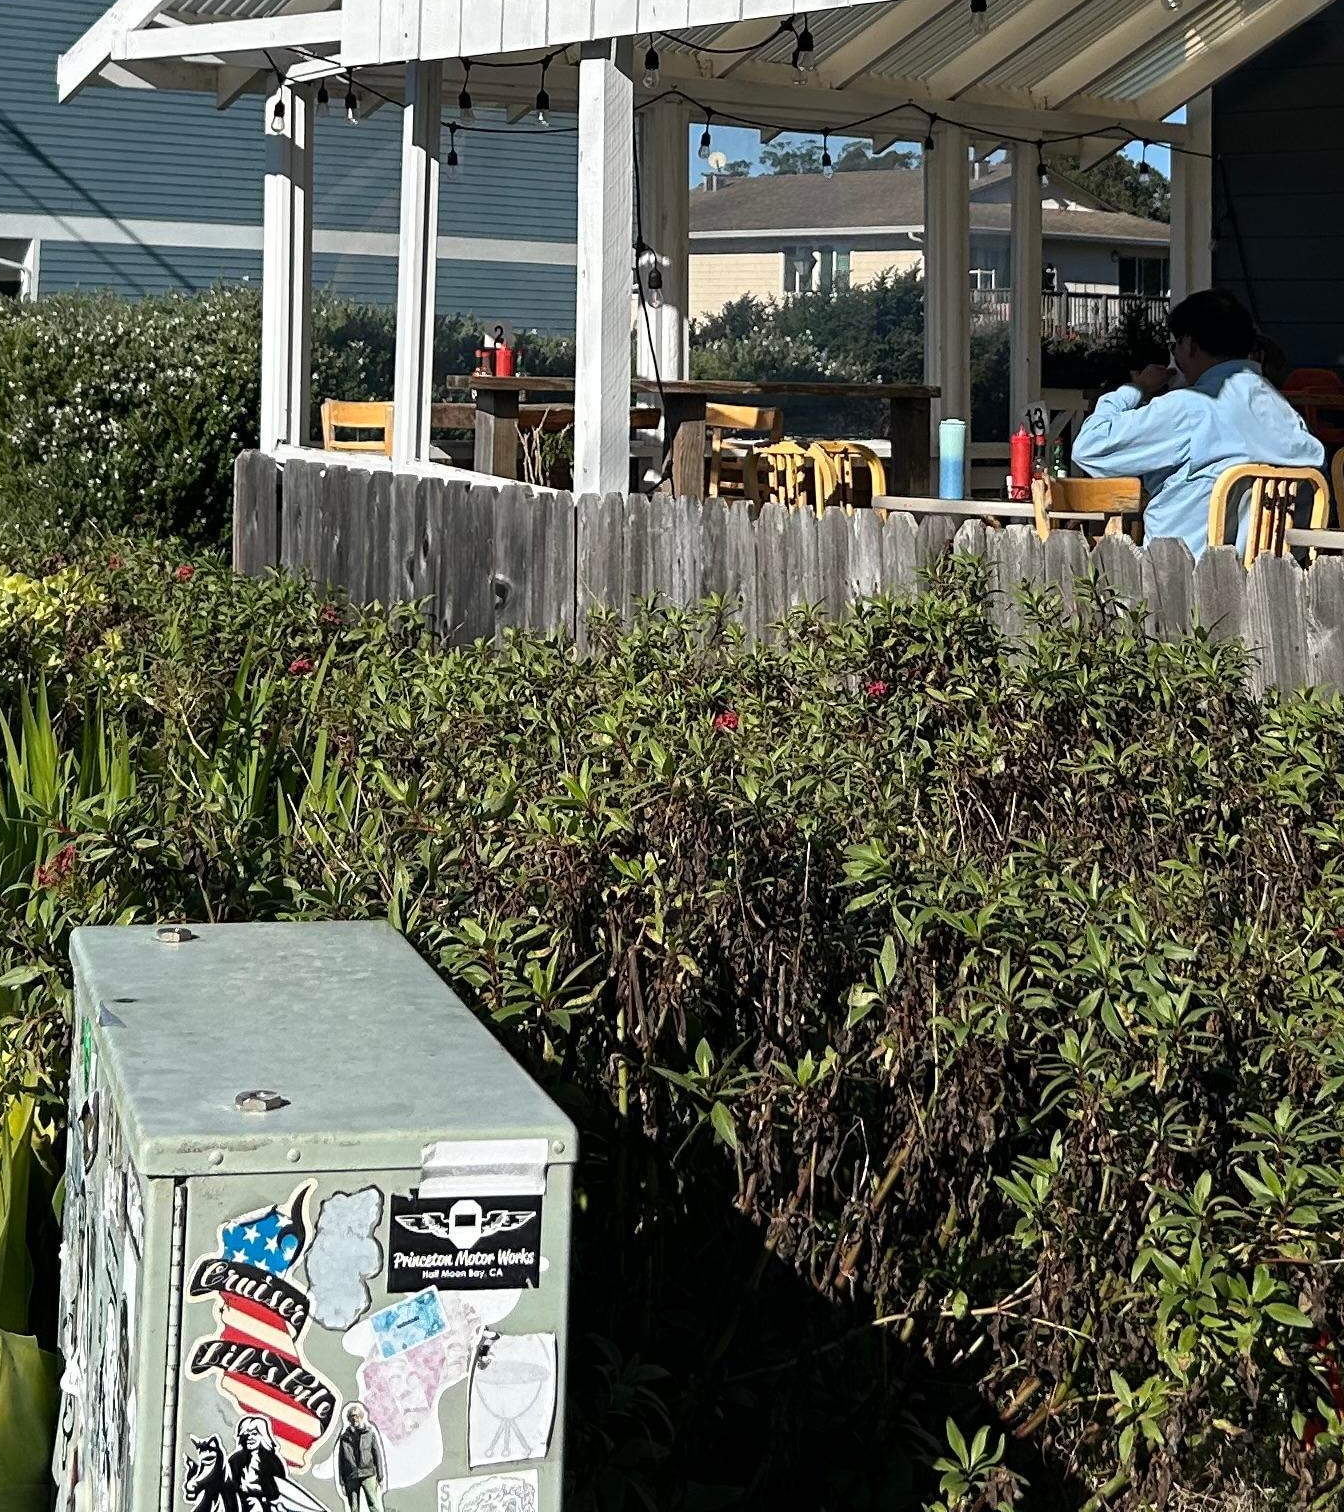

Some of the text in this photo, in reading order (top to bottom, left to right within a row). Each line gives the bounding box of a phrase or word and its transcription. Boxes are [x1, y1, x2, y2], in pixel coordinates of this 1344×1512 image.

[494, 325, 504, 348] 2
[393, 1248, 534, 1269] Princeton Motor Works
[441, 1269, 466, 1278] Moon
[489, 1268, 503, 1277] CA
[201, 1262, 304, 1326] Cruiser
[197, 1342, 331, 1419] Lifestyle
